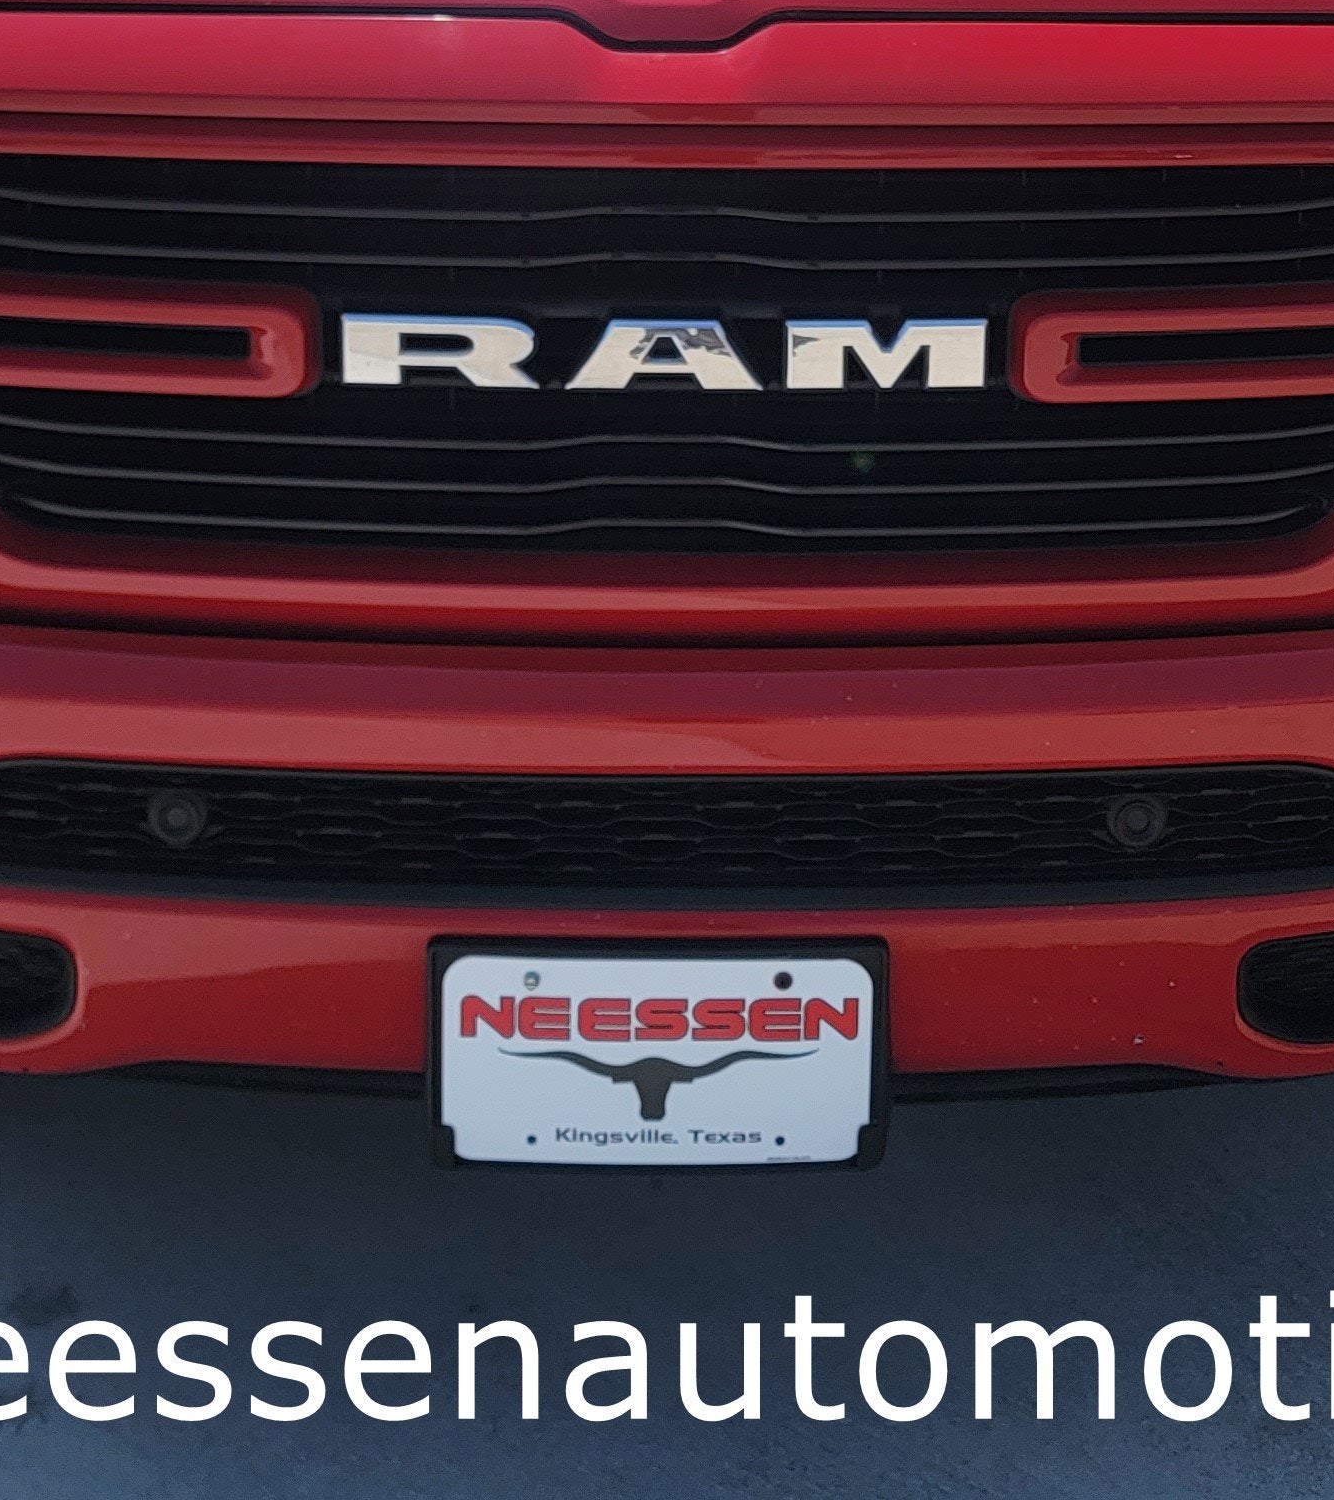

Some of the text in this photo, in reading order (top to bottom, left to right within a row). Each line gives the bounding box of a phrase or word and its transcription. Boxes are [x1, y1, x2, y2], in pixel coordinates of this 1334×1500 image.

[342, 313, 988, 390] RAM
[459, 996, 860, 1043] NEESSEN
[688, 1129, 762, 1145] Texas
